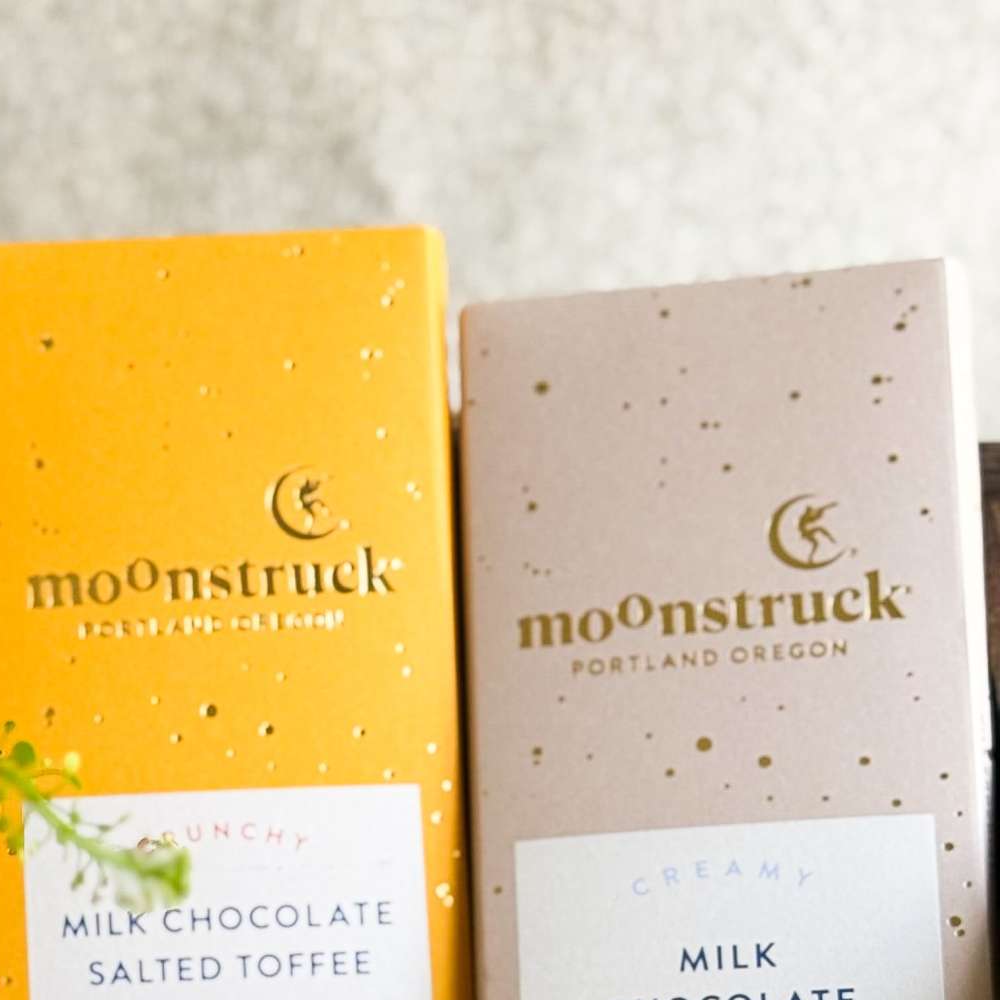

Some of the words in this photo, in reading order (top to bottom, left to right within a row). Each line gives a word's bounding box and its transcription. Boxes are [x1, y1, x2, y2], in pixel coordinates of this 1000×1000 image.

[27, 546, 396, 609] moonstruck
[517, 569, 905, 649] moonstruck
[572, 649, 719, 676] PORTLAND
[730, 640, 849, 665] OREGON
[632, 859, 816, 897] CREAMY
[61, 909, 147, 938] MILK
[162, 901, 394, 934] CHOCOLATE
[89, 956, 222, 986] SALTED
[237, 950, 371, 979] TOFFEE
[679, 942, 777, 973] MILK
